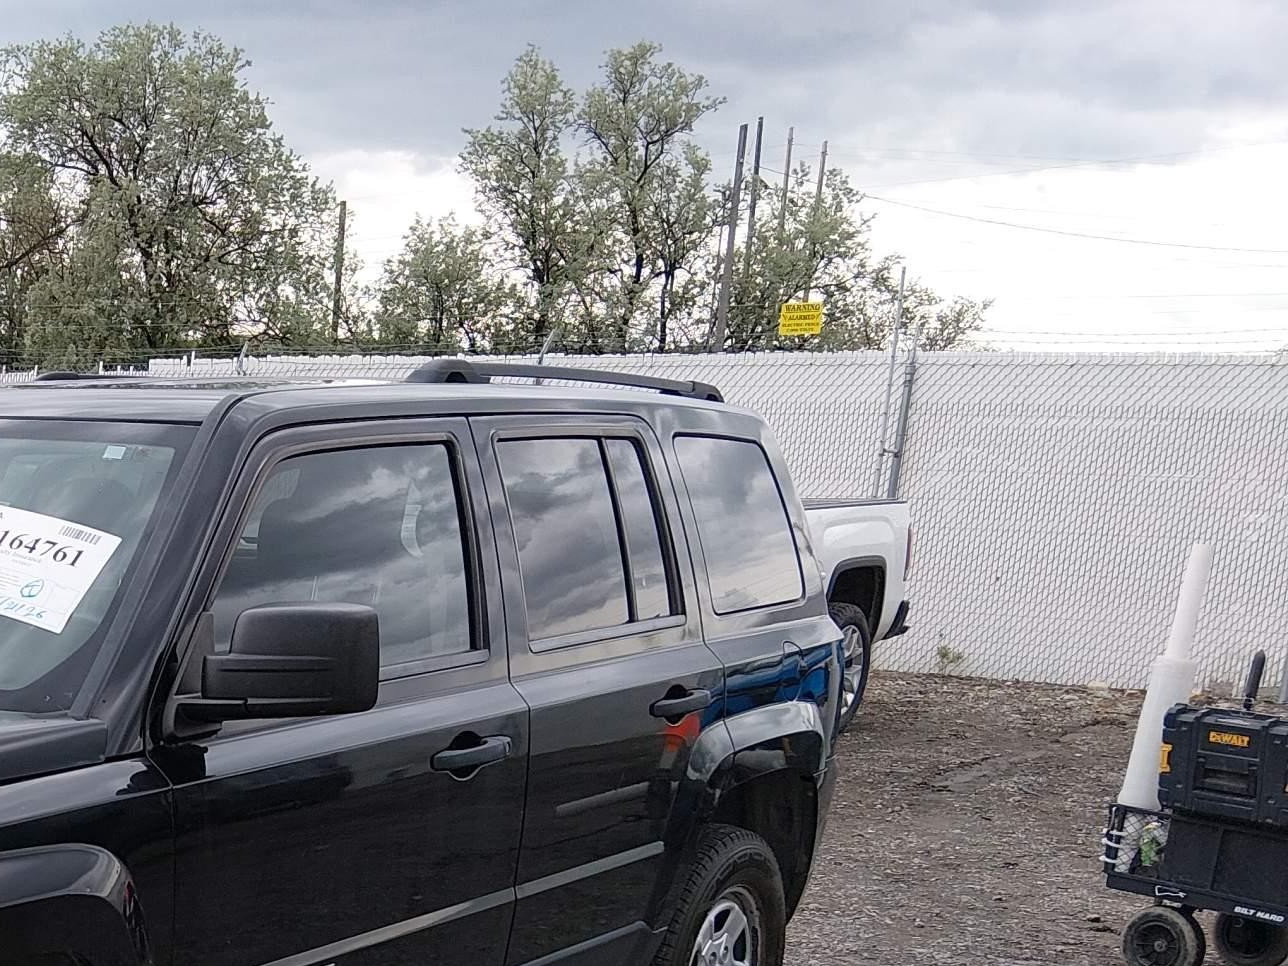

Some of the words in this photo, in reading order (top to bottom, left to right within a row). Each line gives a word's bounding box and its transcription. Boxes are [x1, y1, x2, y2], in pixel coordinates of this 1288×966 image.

[785, 304, 821, 312] WARNING
[1234, 906, 1257, 917] BILT
[1256, 911, 1285, 923] HARD
